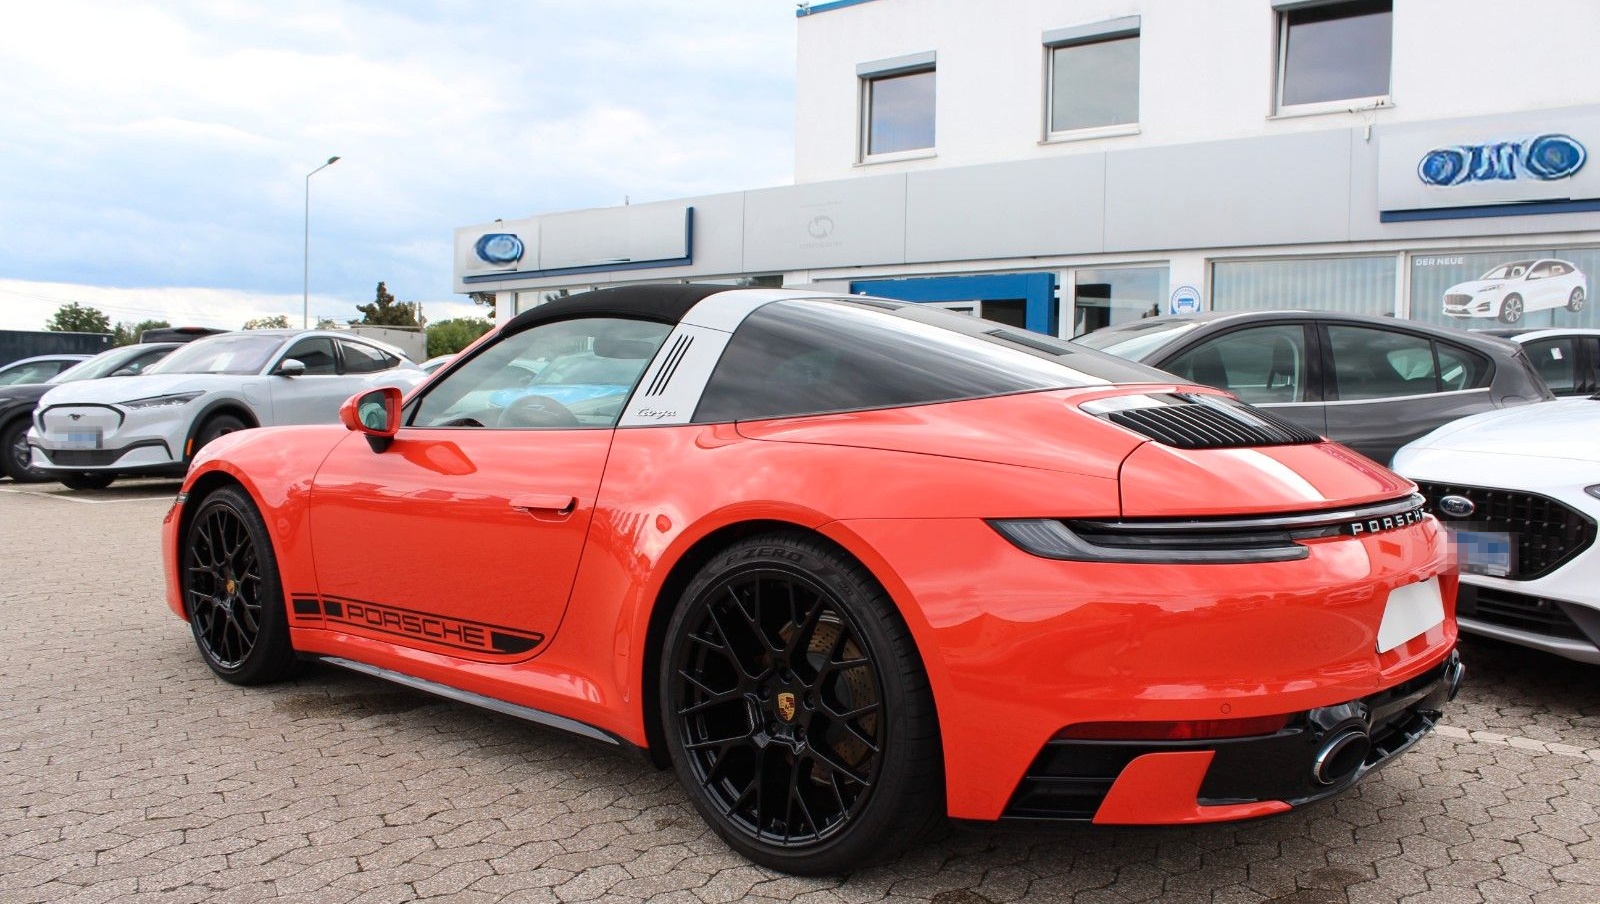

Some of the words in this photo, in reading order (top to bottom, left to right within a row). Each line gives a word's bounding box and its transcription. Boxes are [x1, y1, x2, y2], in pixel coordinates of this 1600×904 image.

[1416, 257, 1436, 267] DER
[1437, 257, 1464, 266] NEUE
[725, 553, 738, 567] P
[742, 547, 803, 563] ZERO
[347, 604, 486, 647] PORSCHE
